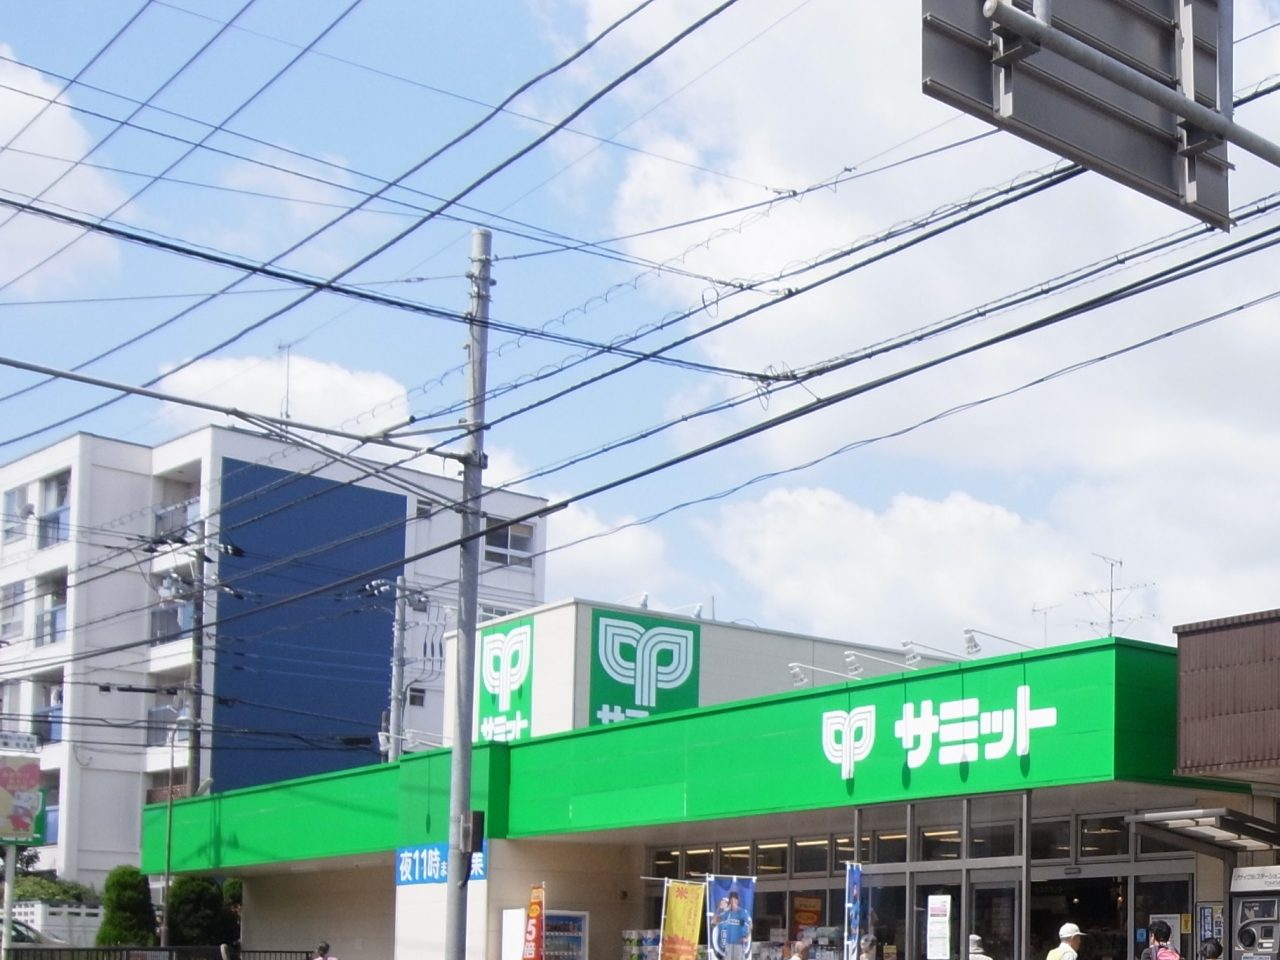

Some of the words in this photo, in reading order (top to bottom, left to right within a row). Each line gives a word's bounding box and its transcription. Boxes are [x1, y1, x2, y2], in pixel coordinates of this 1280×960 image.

[480, 710, 528, 742] サミット
[894, 684, 1057, 768] サミット
